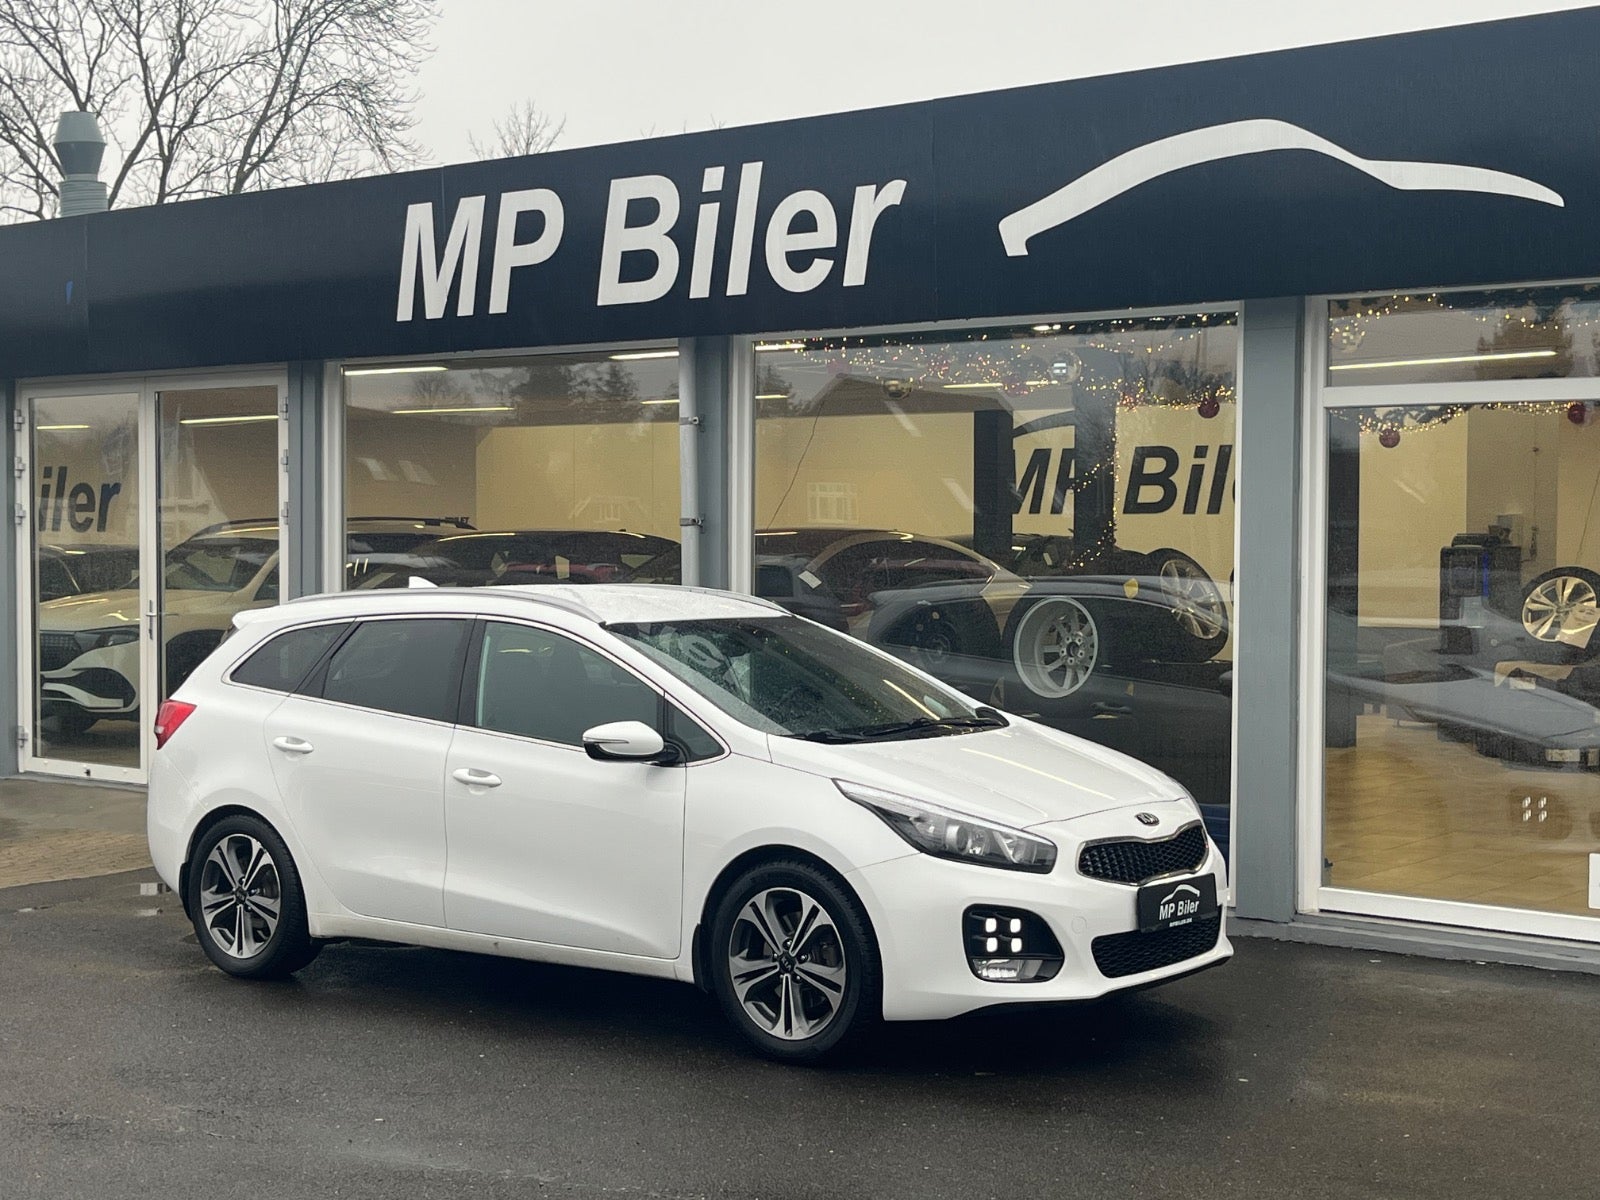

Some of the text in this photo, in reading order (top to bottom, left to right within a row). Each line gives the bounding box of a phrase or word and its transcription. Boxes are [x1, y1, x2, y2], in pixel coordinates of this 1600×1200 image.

[396, 161, 907, 321] MP Biler
[1122, 444, 1236, 515] Bil
[1159, 899, 1200, 921] MP Biler
